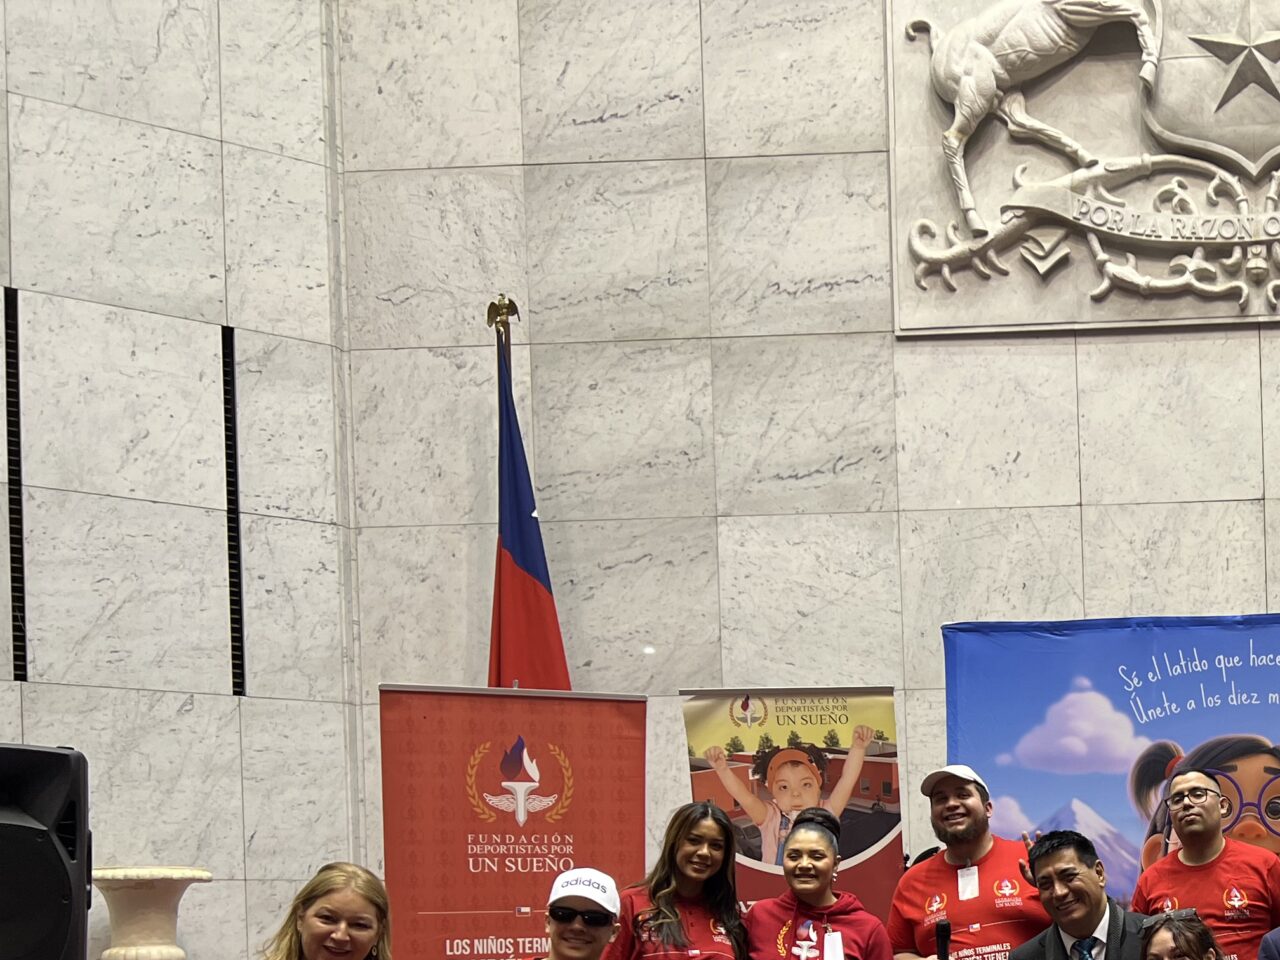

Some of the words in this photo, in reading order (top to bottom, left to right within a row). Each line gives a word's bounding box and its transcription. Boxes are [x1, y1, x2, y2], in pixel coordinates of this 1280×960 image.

[1072, 198, 1125, 232] POR
[1130, 213, 1162, 239] LA
[1170, 216, 1254, 240] RAZON
[1118, 665, 1143, 692] Sé
[1148, 656, 1162, 682] el
[1163, 647, 1209, 677] latido
[1215, 654, 1243, 682] que
[775, 696, 848, 705] FUNDACIÓN
[1130, 691, 1181, 724] Únete
[1186, 700, 1196, 710] a
[1200, 682, 1222, 708] los
[1227, 680, 1261, 706] diez
[775, 705, 830, 713] DEPORTISTAS
[832, 704, 848, 712] POR
[776, 715, 796, 726] UN
[800, 712, 849, 725] SUEÑO
[467, 832, 574, 844] FUNDACIÓN
[467, 844, 548, 854] DEPORTISTAS
[551, 844, 574, 854] POR
[468, 857, 499, 873] UN
[505, 854, 575, 873] SUEÑO
[561, 877, 607, 894] adidas
[446, 939, 470, 955] LOS
[474, 936, 514, 955] NIÑOS
[976, 943, 1011, 954] TERMINALES
